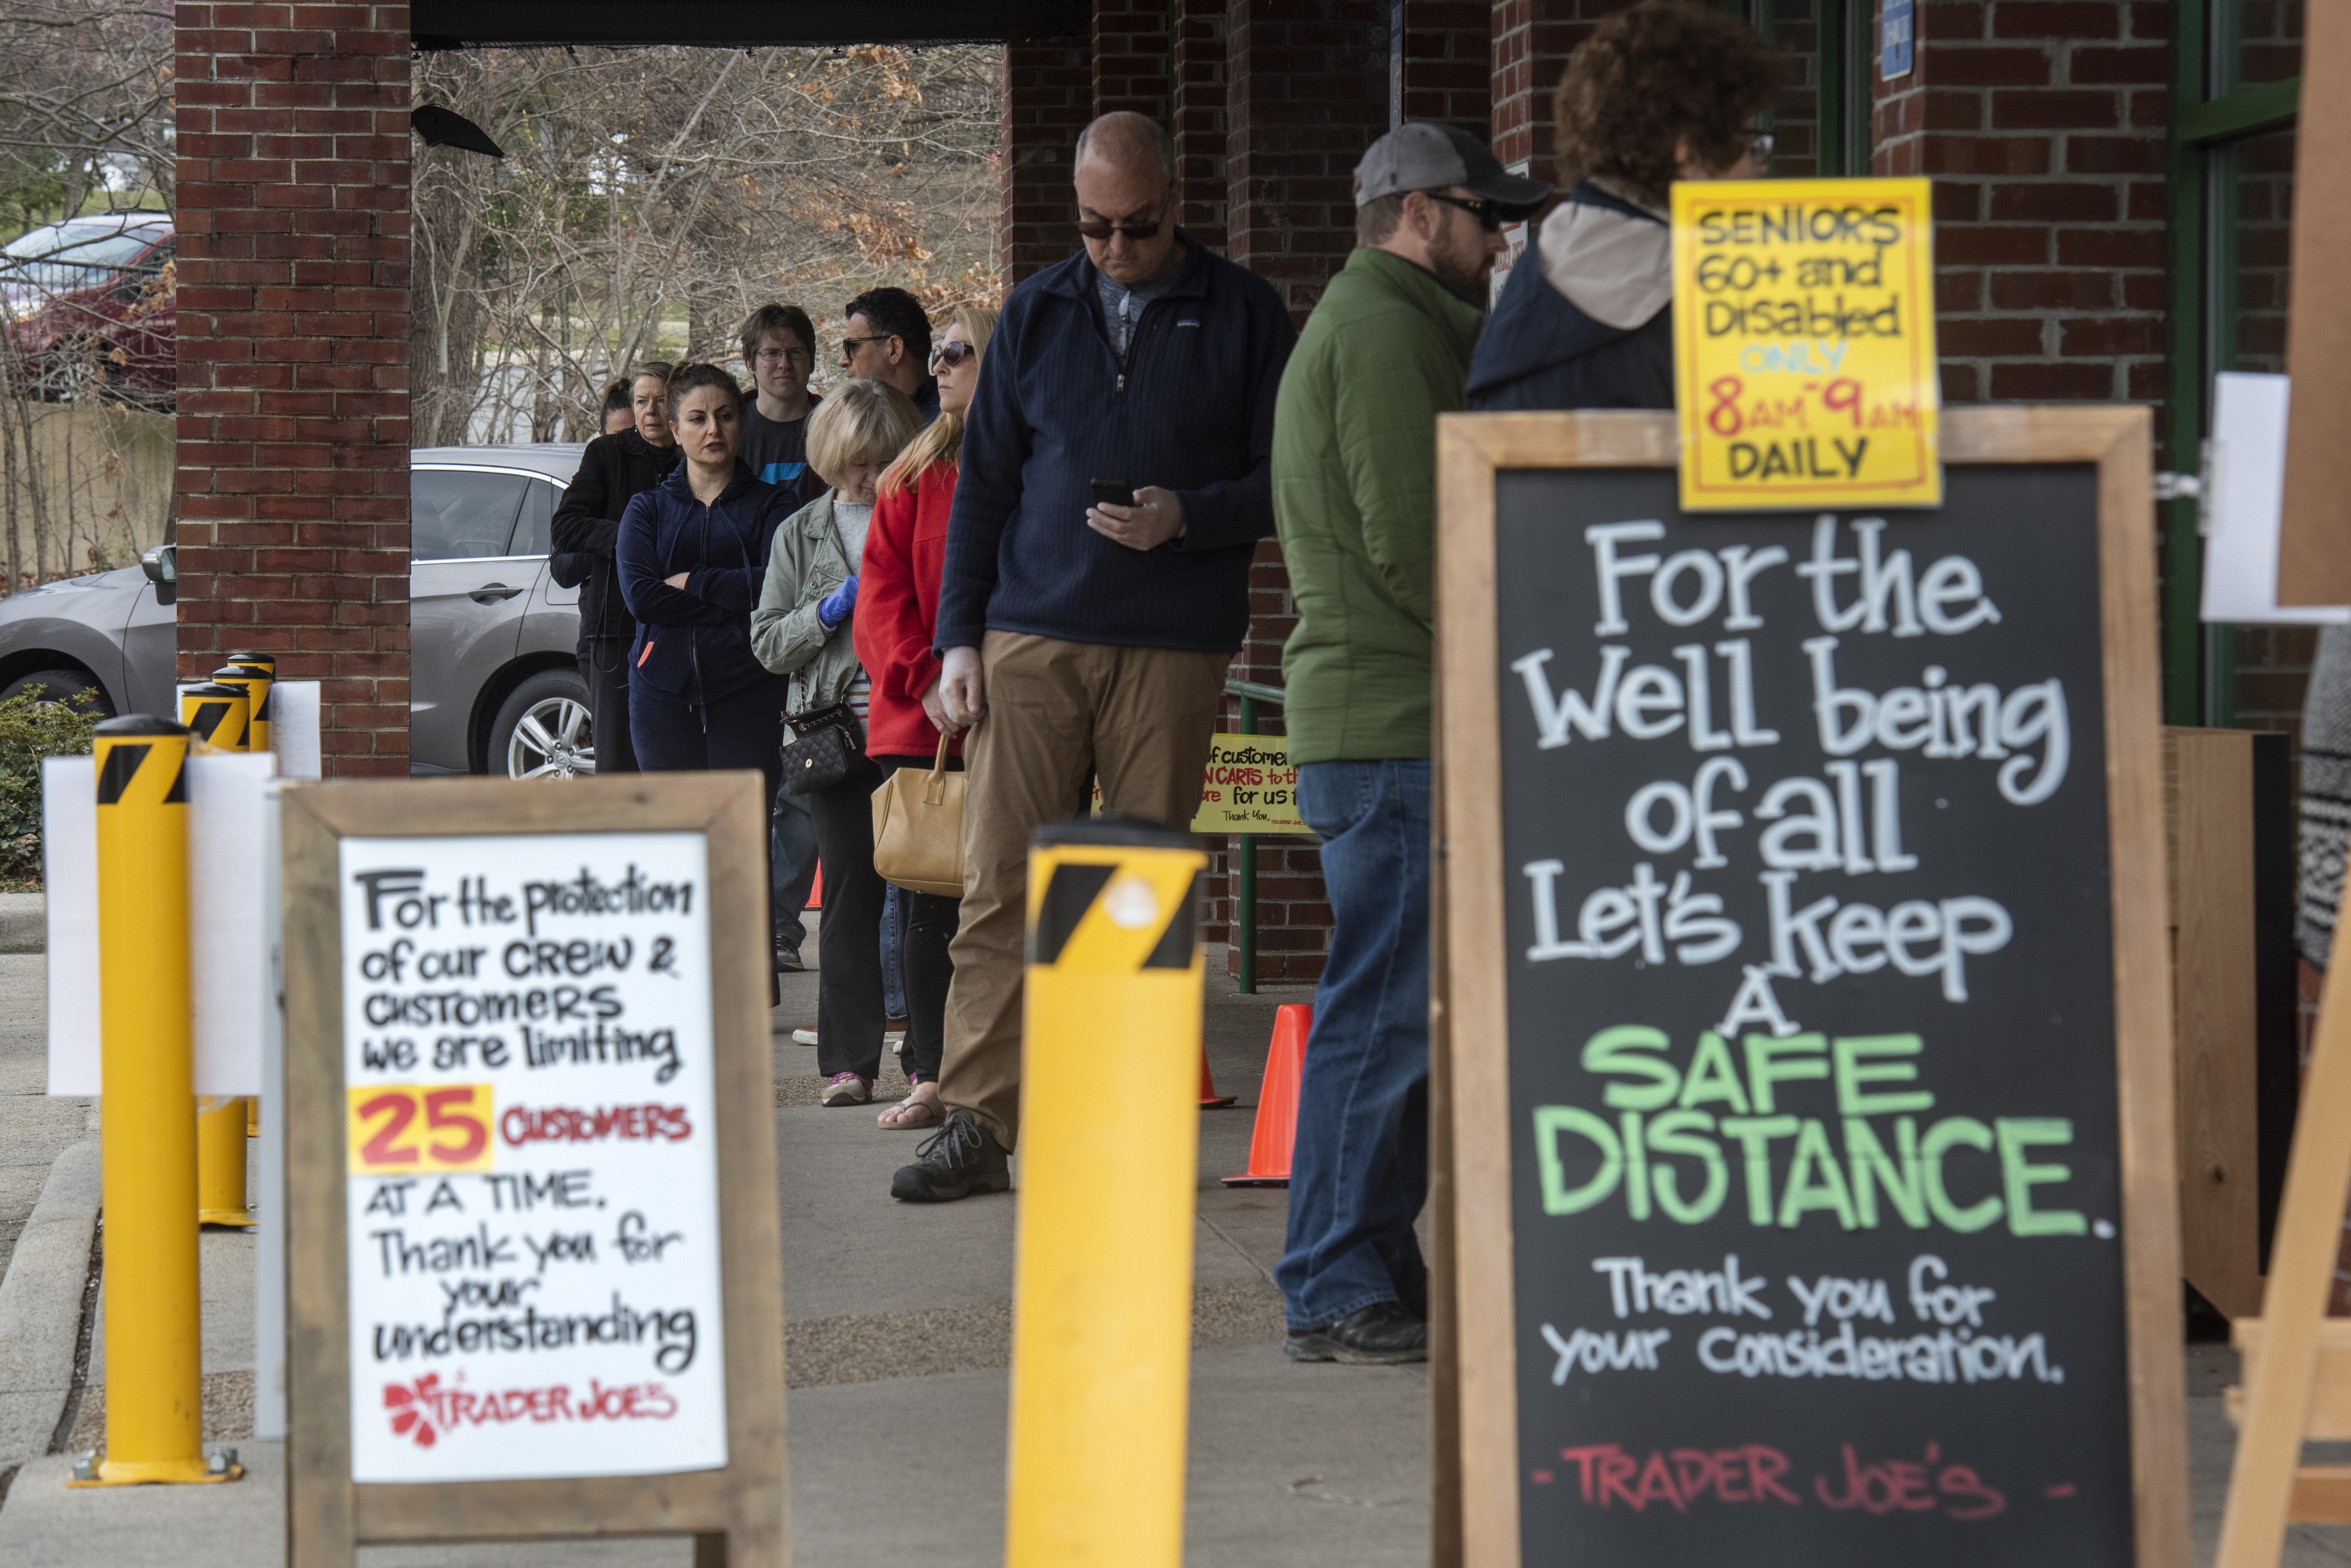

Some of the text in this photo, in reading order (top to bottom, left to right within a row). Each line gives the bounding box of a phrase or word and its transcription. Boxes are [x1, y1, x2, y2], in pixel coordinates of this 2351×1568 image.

[1698, 206, 1901, 246] SENIORS
[1697, 246, 1883, 294] 60+ and
[1738, 339, 1849, 375] ONLY
[1728, 435, 1867, 480] DAILY
[1585, 514, 2001, 637] For the
[1511, 636, 2070, 806] Well being
[1215, 766, 1263, 786] CARTS
[1266, 768, 1283, 784] to
[1233, 786, 1259, 805] for
[1263, 790, 1288, 805] us
[1222, 809, 1250, 821] Thank
[1625, 755, 1919, 875] of all
[353, 863, 694, 937] For the protection
[1523, 860, 2013, 1003] Let's keep
[361, 936, 414, 984] of
[418, 944, 487, 981] our
[1714, 965, 1801, 1038] A
[432, 1034, 509, 1071] are
[520, 1019, 685, 1085] limiting
[1581, 1024, 1934, 1116] SAFE
[357, 1086, 693, 1166] 25 CUSTOMERS
[364, 1169, 607, 1216] AT A TIME.
[1533, 1104, 2117, 1239] DISTANCE.
[368, 1210, 685, 1277] Thank you for
[440, 1276, 542, 1317] your
[1592, 1254, 1995, 1325] Thank you for
[373, 1288, 697, 1375] understanding
[1542, 1324, 1670, 1386] your
[433, 1384, 574, 1432] TRADER
[1560, 1443, 1802, 1512] TRADER
